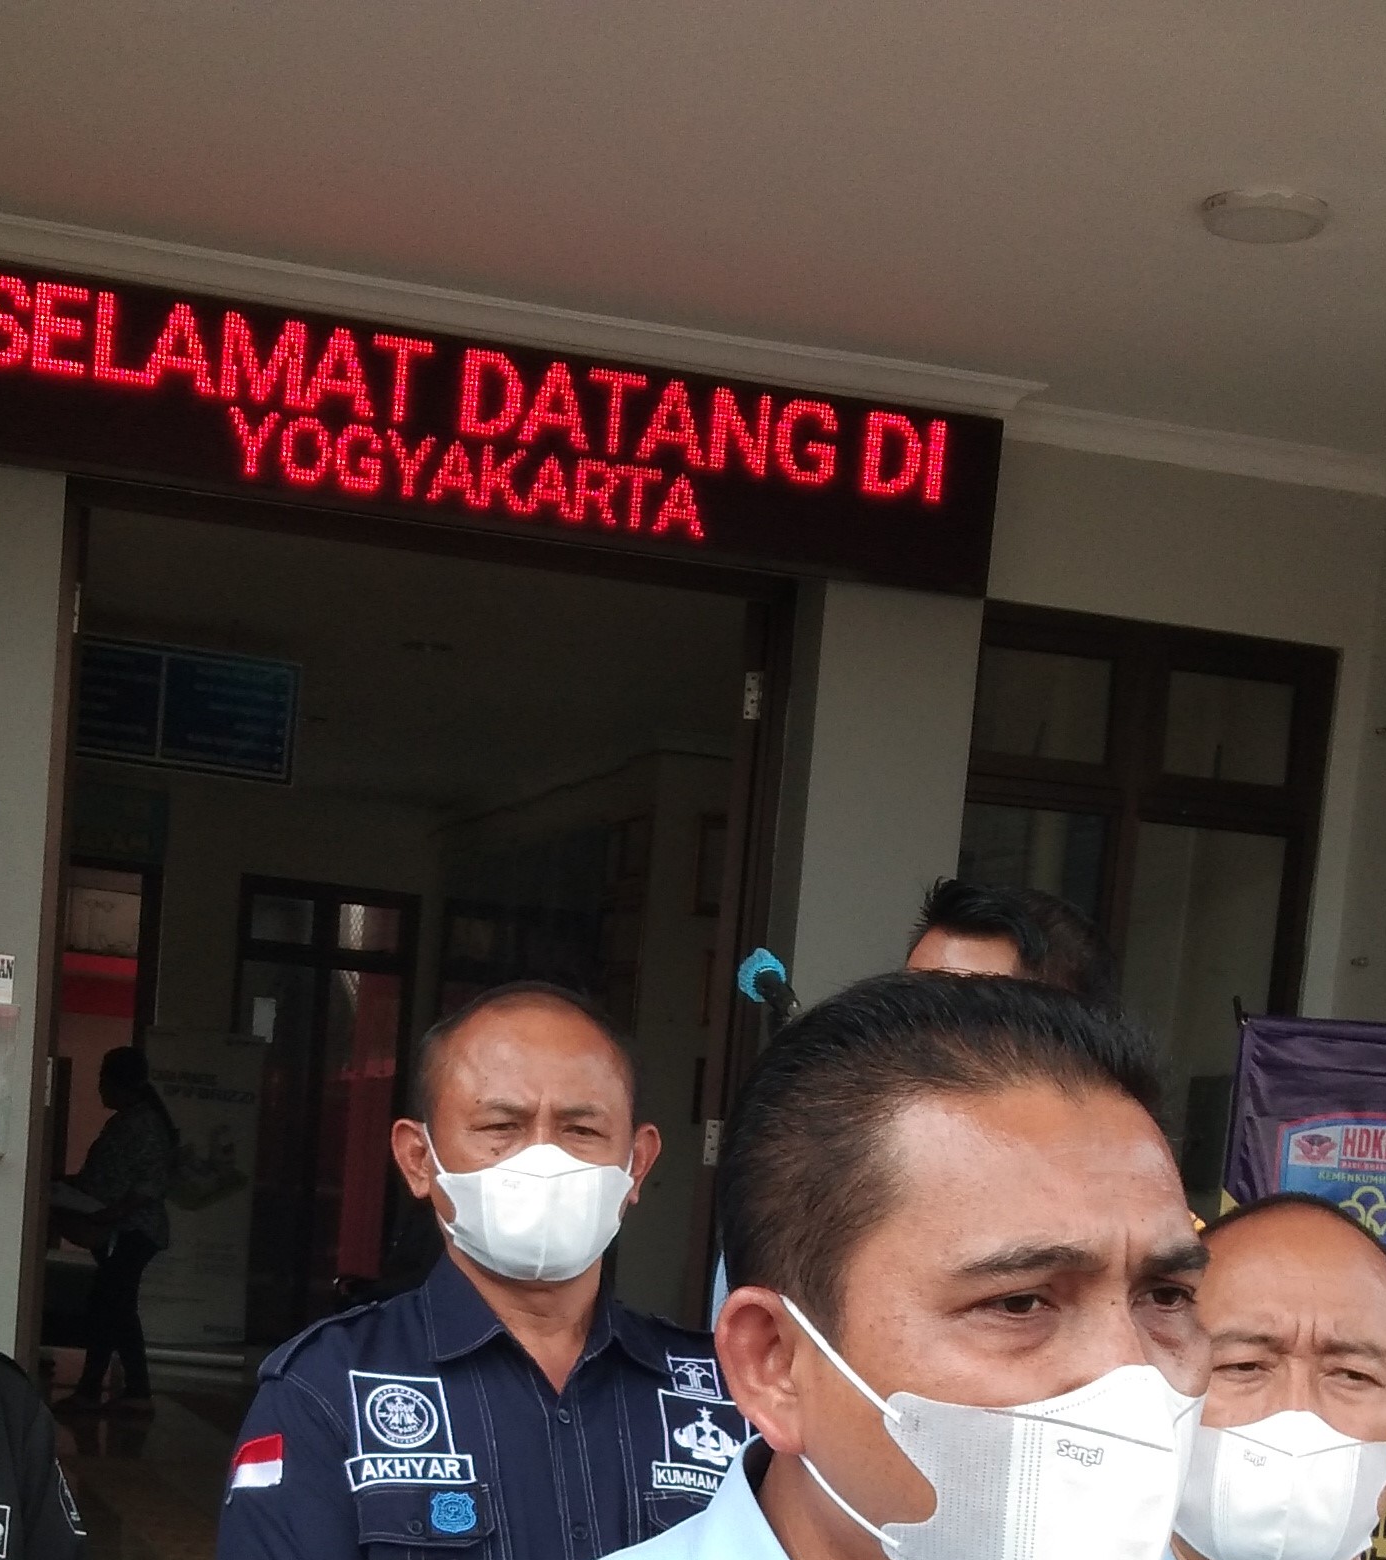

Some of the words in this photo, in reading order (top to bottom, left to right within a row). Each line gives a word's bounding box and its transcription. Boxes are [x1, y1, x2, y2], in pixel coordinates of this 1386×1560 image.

[459, 347, 839, 484] DATANG
[861, 411, 947, 503] DI
[228, 406, 705, 539] YOGYAKARTA
[1057, 1439, 1104, 1466] Sensi
[361, 1458, 462, 1481] AKHYAR
[657, 1469, 719, 1491] KUMHAM
